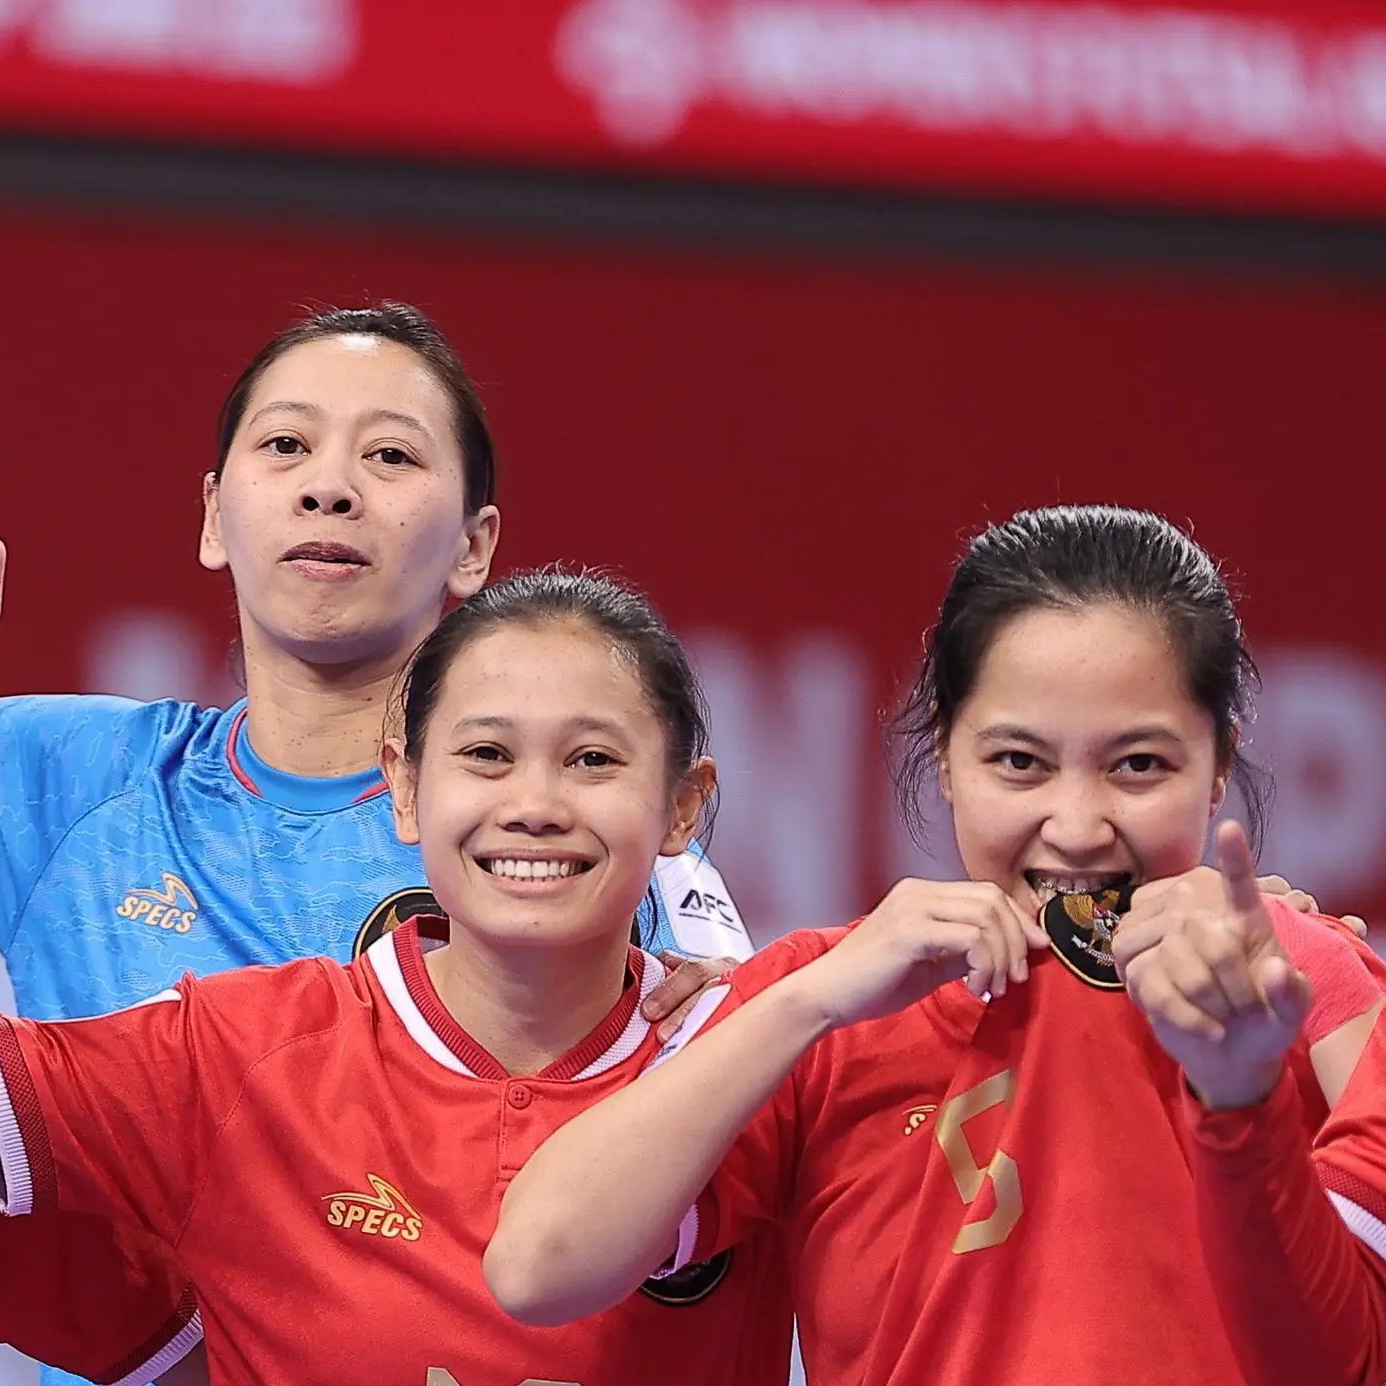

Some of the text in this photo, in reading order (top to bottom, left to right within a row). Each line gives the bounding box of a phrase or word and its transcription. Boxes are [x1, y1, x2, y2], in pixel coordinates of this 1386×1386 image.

[117, 897, 197, 933] SPECS
[679, 889, 733, 922] AFC
[937, 1068, 1024, 1255] 5
[327, 1200, 423, 1241] SPECS
